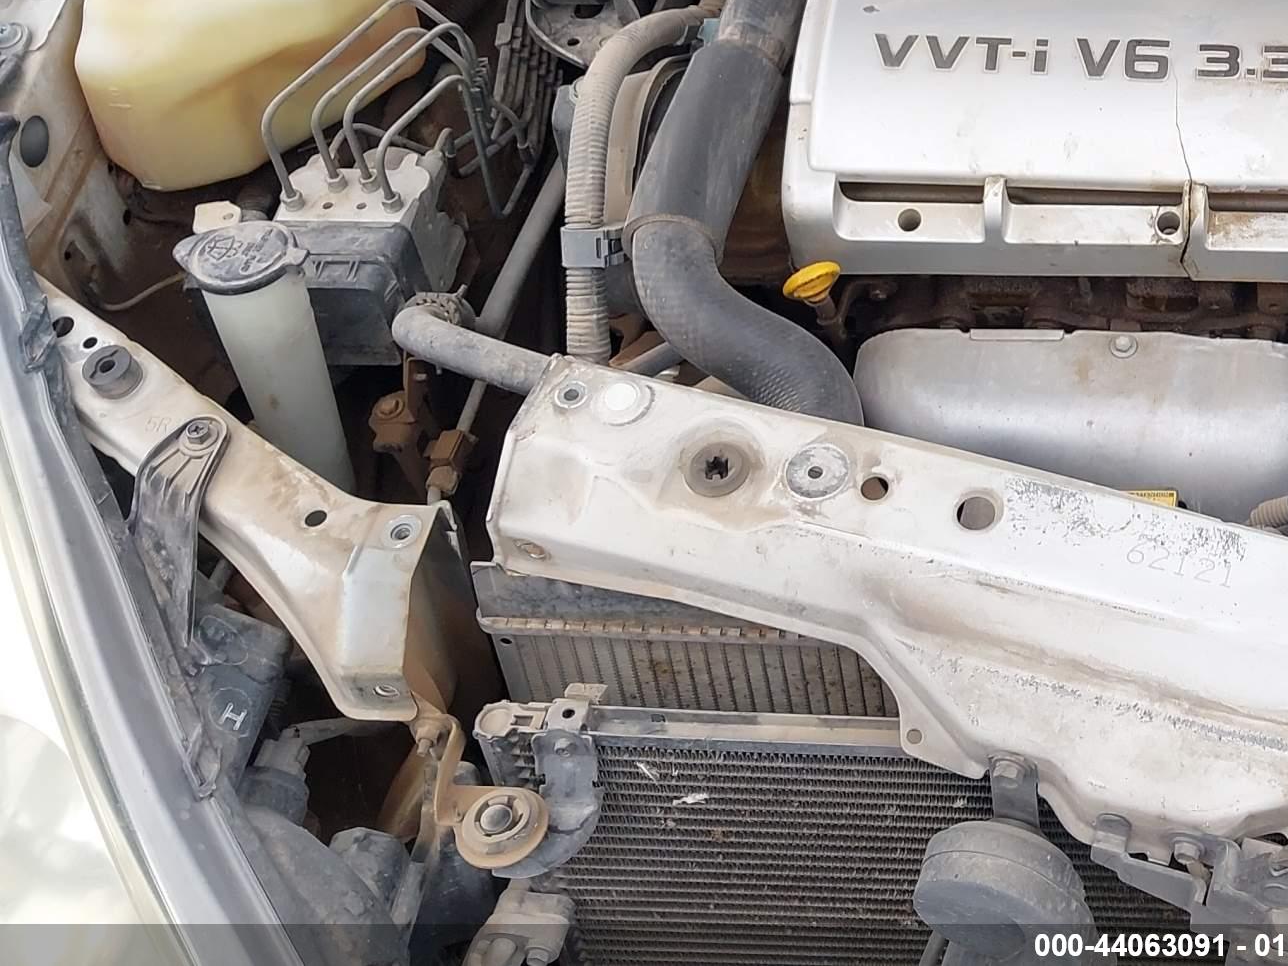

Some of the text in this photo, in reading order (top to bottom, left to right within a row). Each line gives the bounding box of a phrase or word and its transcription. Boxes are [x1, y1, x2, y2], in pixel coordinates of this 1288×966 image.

[874, 34, 1050, 75] VVT-i
[1076, 37, 1172, 81] V6
[1127, 538, 1232, 588] 62121
